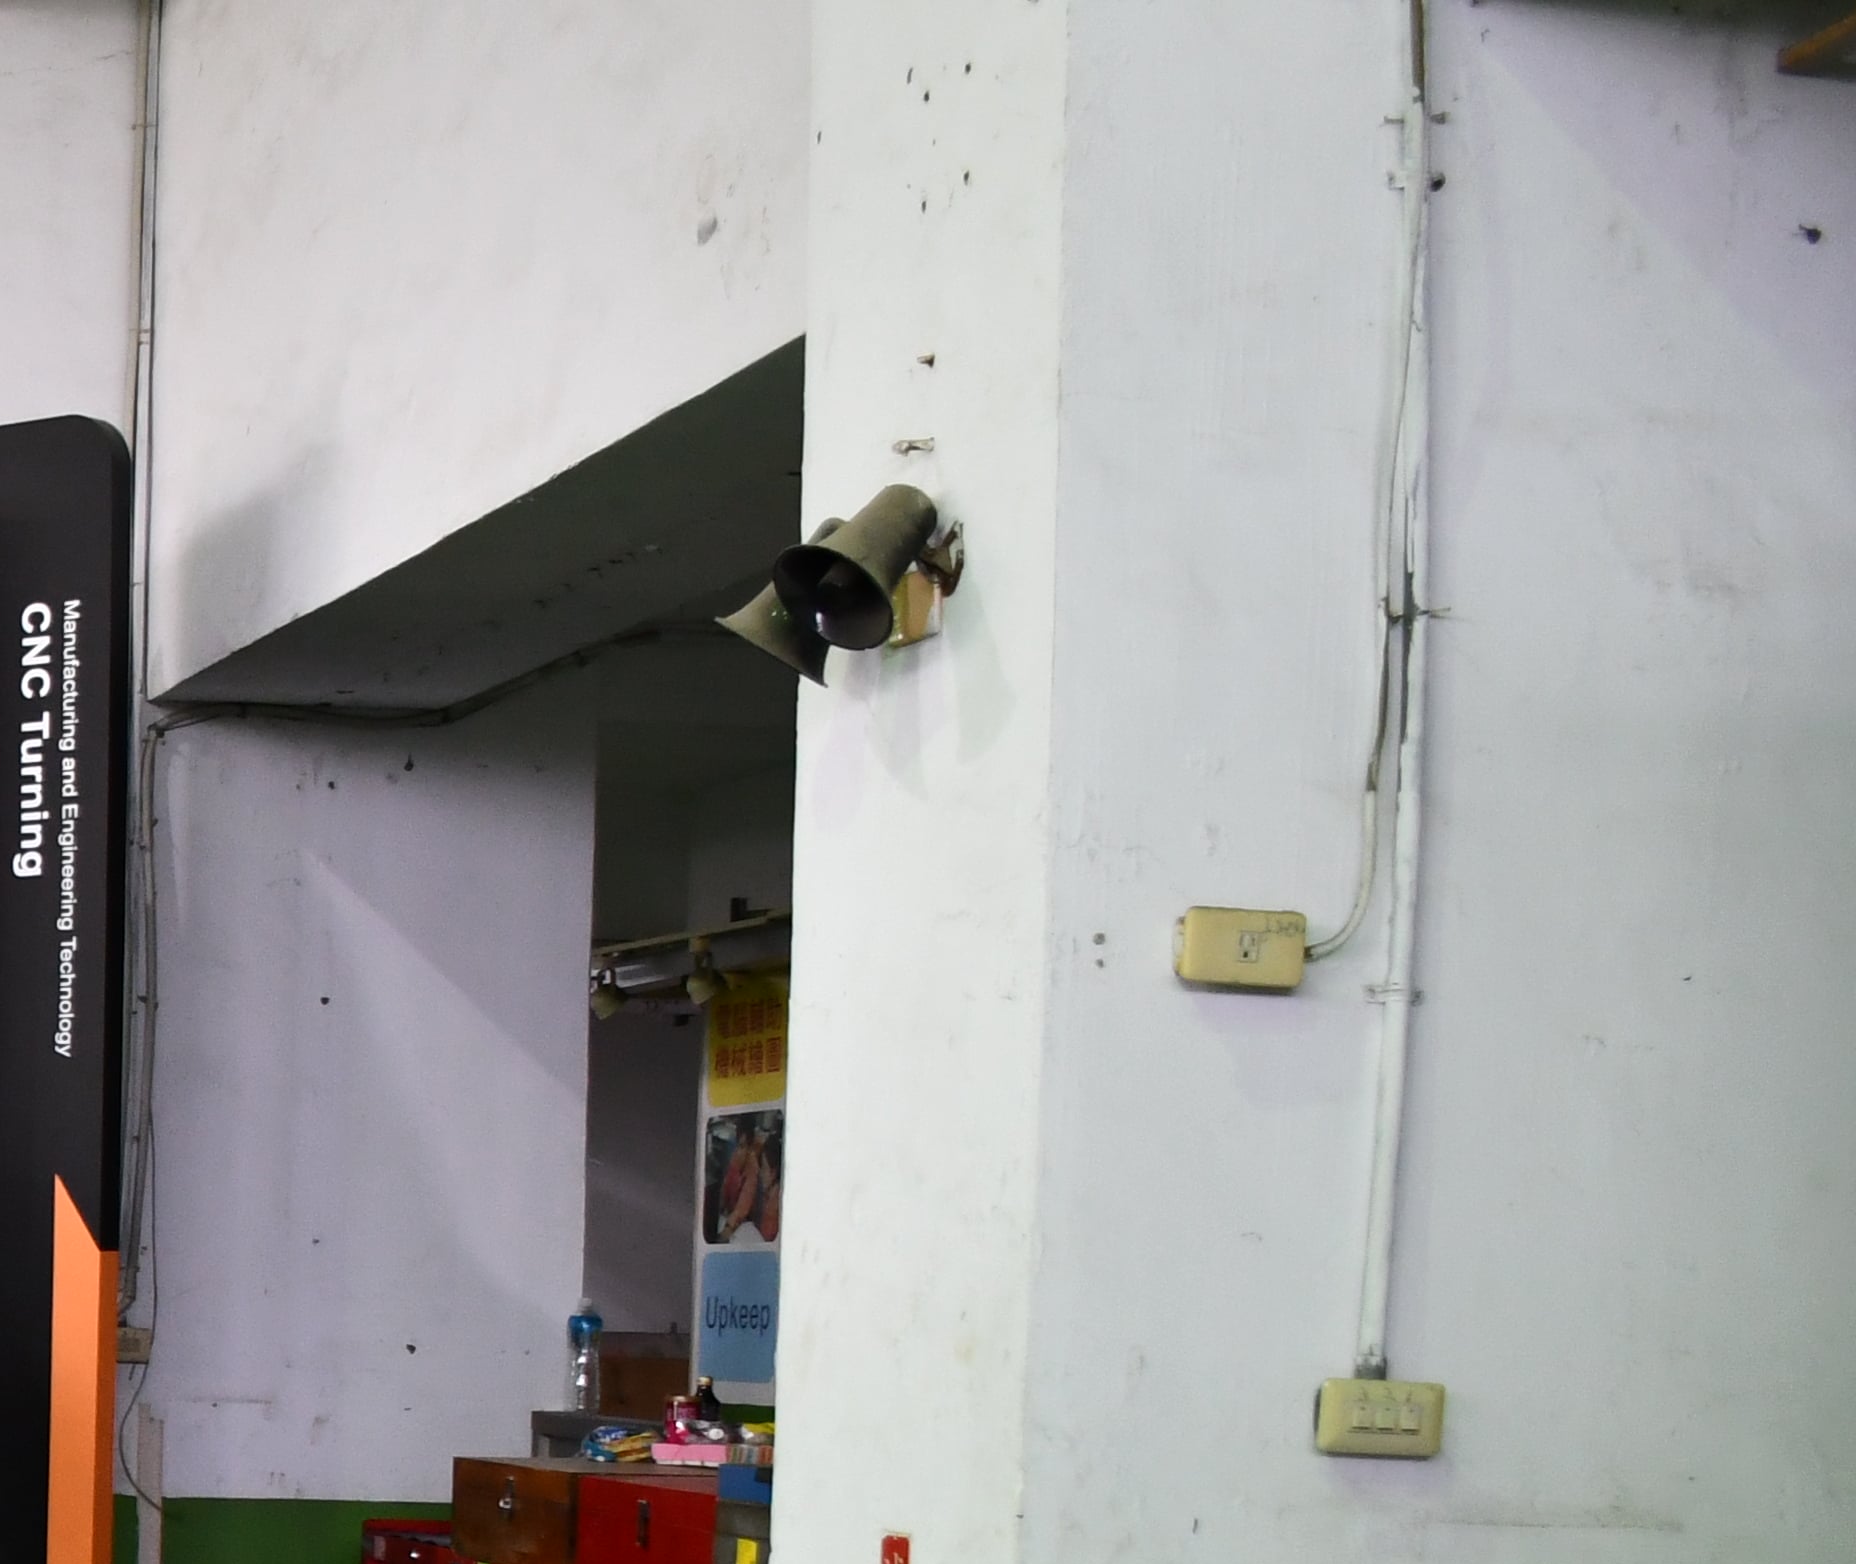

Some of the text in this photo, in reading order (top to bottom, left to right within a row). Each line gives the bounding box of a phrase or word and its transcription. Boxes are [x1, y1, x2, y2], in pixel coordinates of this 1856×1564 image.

[12, 602, 52, 878] CNC Turning
[53, 599, 80, 1058] Manufacturing and Engineering Technology
[705, 1295, 771, 1338] Upkeep
